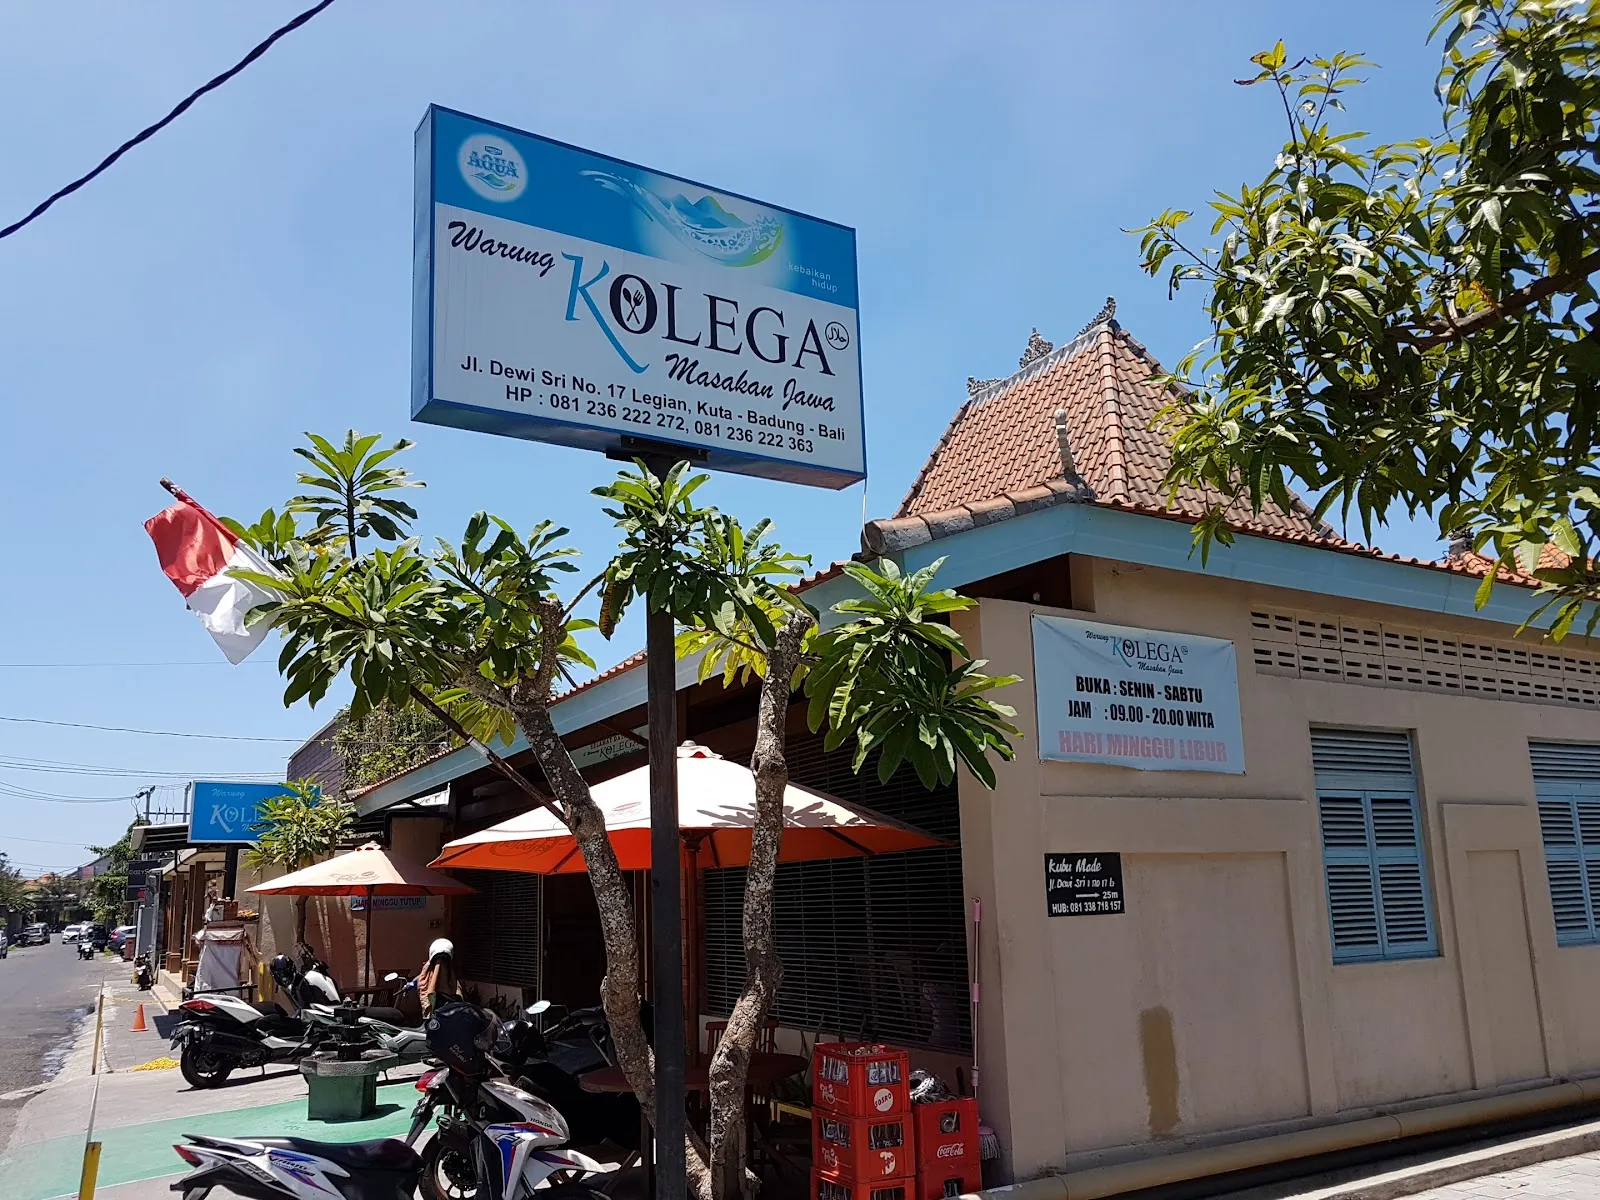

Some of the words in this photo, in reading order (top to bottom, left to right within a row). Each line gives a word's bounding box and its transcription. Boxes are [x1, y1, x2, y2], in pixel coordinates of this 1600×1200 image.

[468, 150, 519, 178] AQUA
[448, 220, 556, 277] Warung
[788, 262, 831, 281] kebaikan
[812, 278, 838, 293] hidup
[561, 251, 836, 376] KOLEGA
[665, 353, 774, 399] Masakan
[782, 378, 836, 412] Jawa
[460, 355, 483, 373] Jl.
[490, 360, 535, 382] Dewi
[541, 370, 566, 388] Sri
[572, 376, 600, 395] No.
[607, 384, 626, 399] 17
[632, 388, 692, 414] Legian,
[697, 401, 732, 420] Kuta
[747, 410, 804, 435] Badung
[819, 424, 845, 441] Bali
[506, 385, 532, 402] HP
[550, 393, 579, 411] 081
[587, 400, 617, 418] 236
[622, 407, 651, 425] 222
[656, 413, 689, 434] 272,
[694, 420, 721, 437] 081
[726, 426, 753, 443] 236
[758, 432, 784, 448] 222
[788, 437, 814, 453] 363
[1085, 631, 1109, 643] Warung
[1111, 635, 1184, 668] KOLEGA
[1137, 661, 1166, 673] Masakan
[1167, 664, 1184, 676] Jawa
[1075, 676, 1111, 695] BUKA
[1119, 680, 1155, 699] SENIN
[1164, 684, 1203, 703] SABTU
[1068, 700, 1092, 718] JAM
[1110, 703, 1143, 723] 09.00
[1152, 707, 1184, 726] 20.00
[1186, 710, 1215, 728] WITA
[599, 740, 635, 760] KOLEG
[1058, 730, 1102, 753] HARI
[1107, 733, 1175, 760] MINGGU
[1179, 739, 1228, 762] LIBUR
[212, 788, 245, 799] Warung
[210, 803, 264, 833] KOLE
[1048, 857, 1072, 873] Kubu
[1075, 857, 1102, 872] Made
[1074, 876, 1086, 888] Sri
[355, 899, 369, 907] HAR
[400, 897, 421, 906] TUTUP
[1102, 891, 1118, 899] 25m
[1052, 903, 1069, 913] HUB:
[1070, 902, 1082, 912] 081
[1084, 901, 1097, 912] 338
[1097, 901, 1109, 911] 718
[1110, 900, 1121, 910] 157
[875, 1092, 892, 1108] SOSRO
[530, 1117, 553, 1129] HONDA
